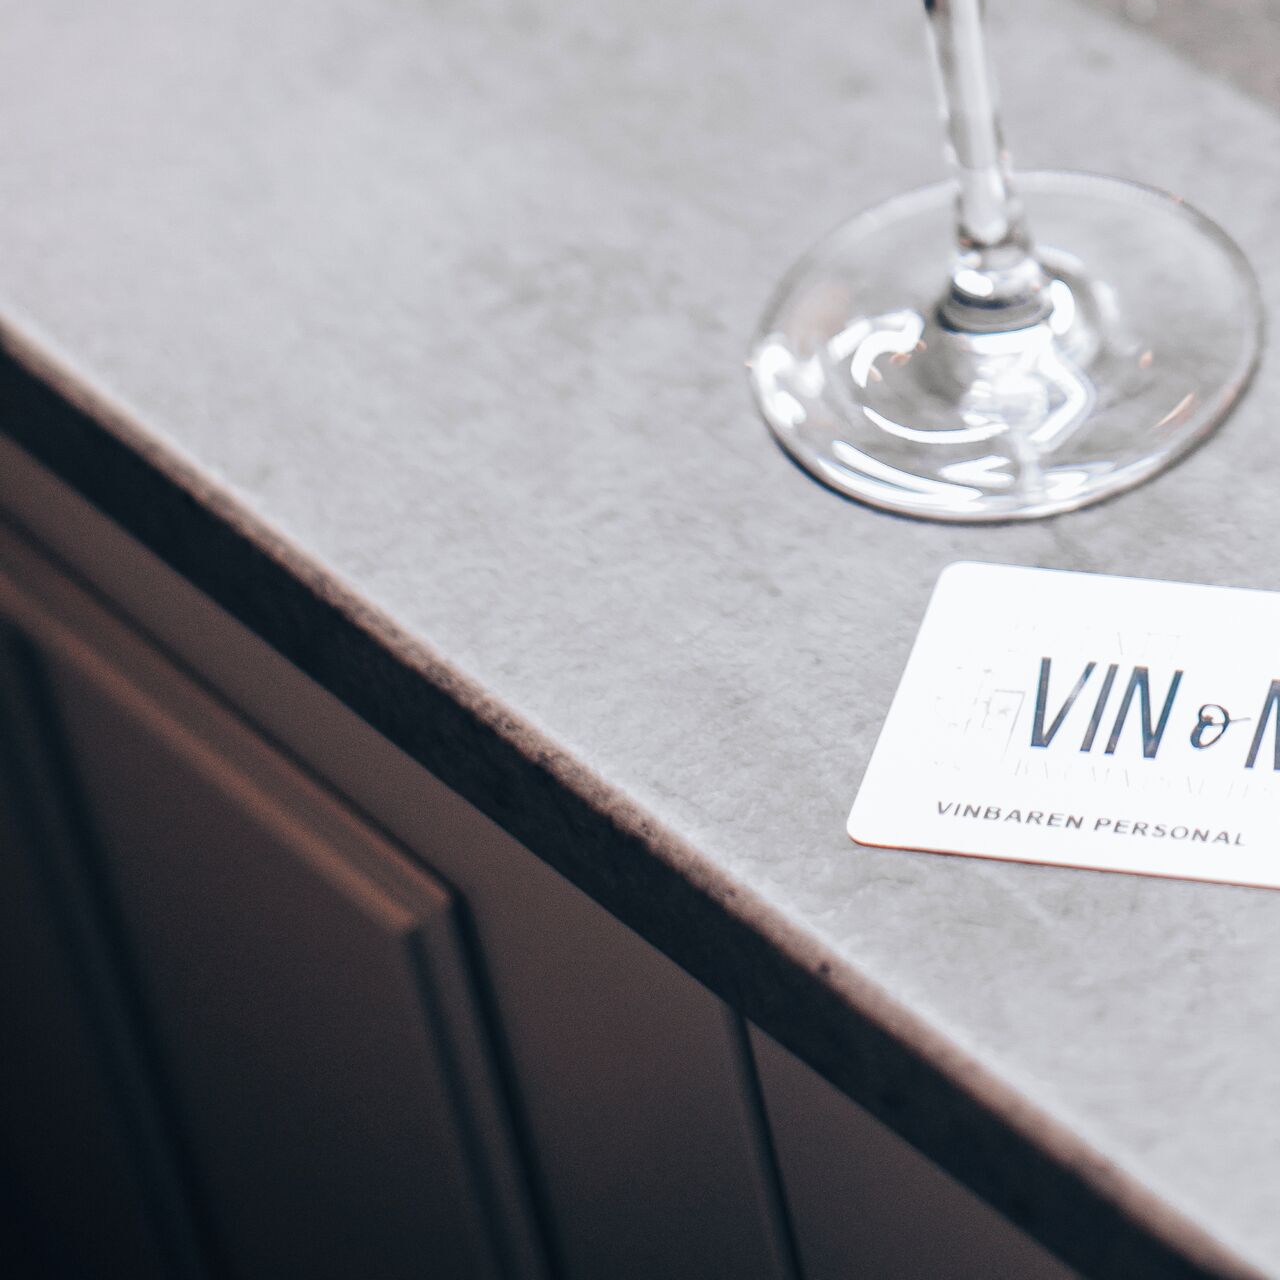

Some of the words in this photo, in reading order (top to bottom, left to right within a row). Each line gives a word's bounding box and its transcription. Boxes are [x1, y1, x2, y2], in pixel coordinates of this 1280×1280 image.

[1030, 656, 1184, 760] VIN
[935, 800, 1084, 829] VINBAREN
[1093, 816, 1245, 847] PERSONAL
